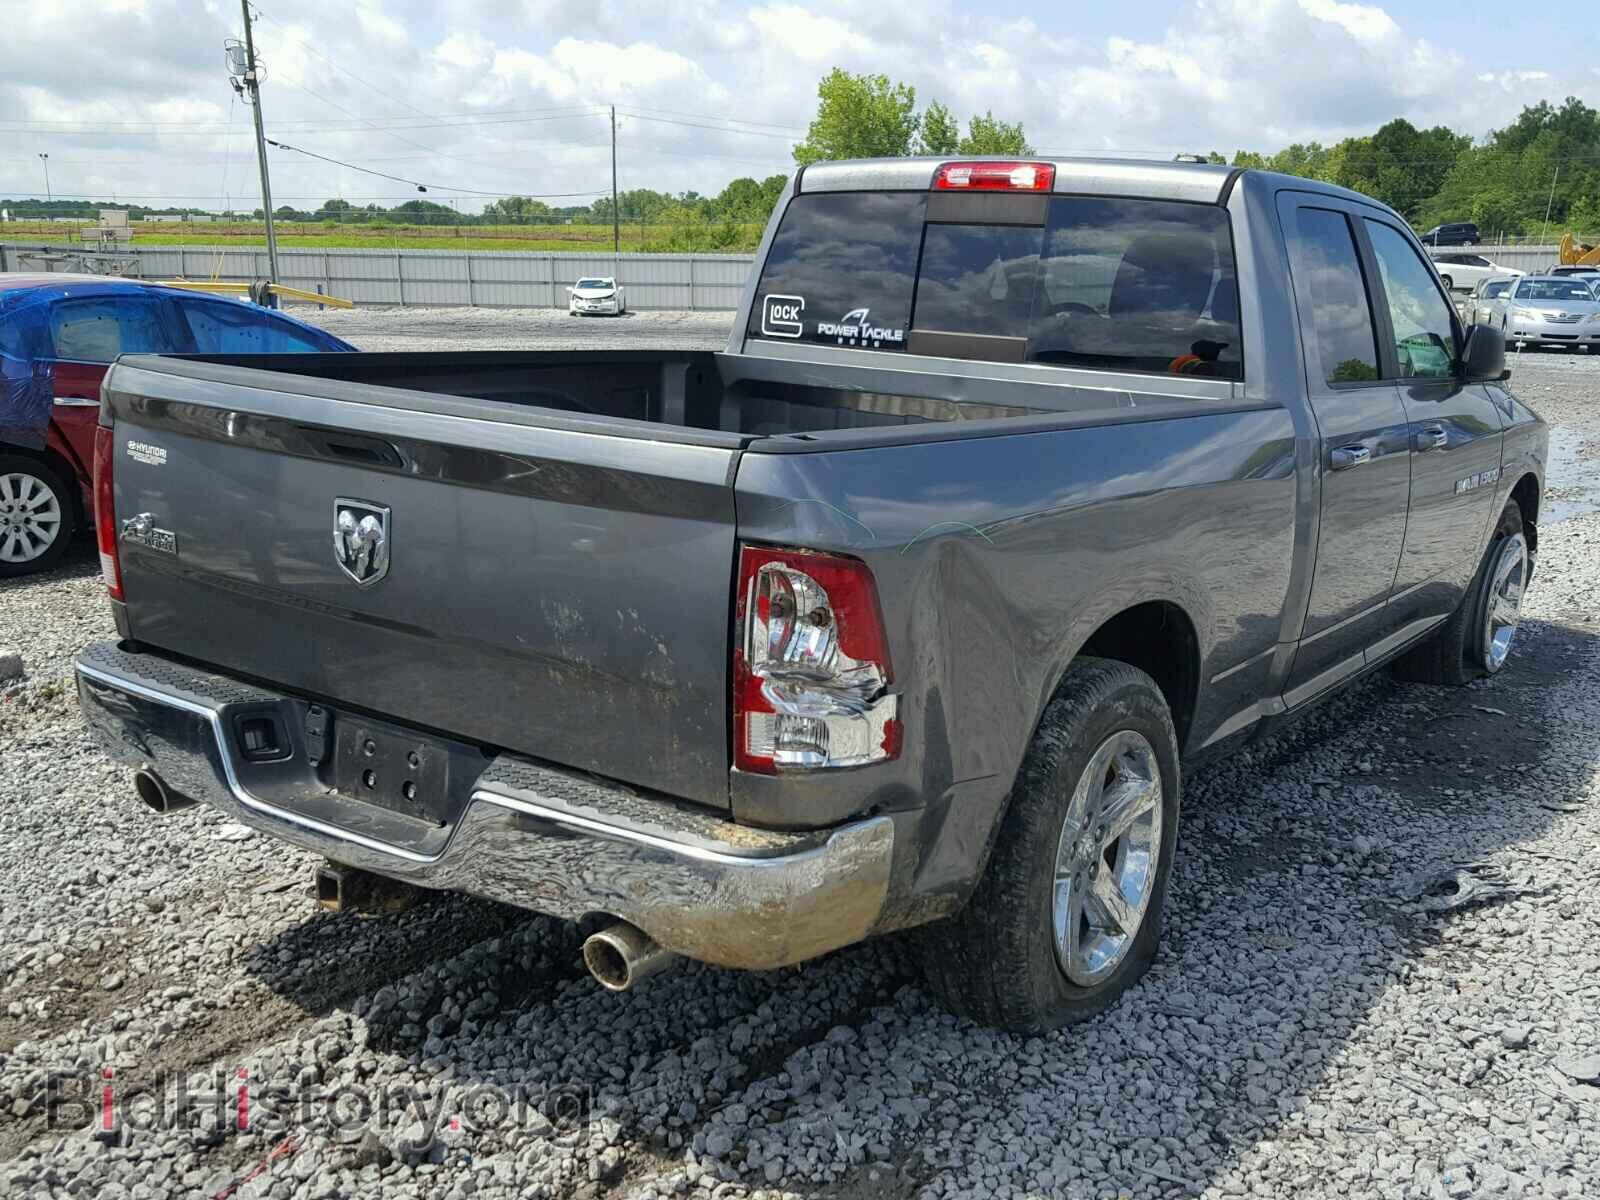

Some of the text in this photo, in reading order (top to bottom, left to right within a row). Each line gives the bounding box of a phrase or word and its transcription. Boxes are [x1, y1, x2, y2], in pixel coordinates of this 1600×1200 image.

[818, 323, 904, 342] POWER TACKLE
[136, 441, 167, 458] HYUNDAI
